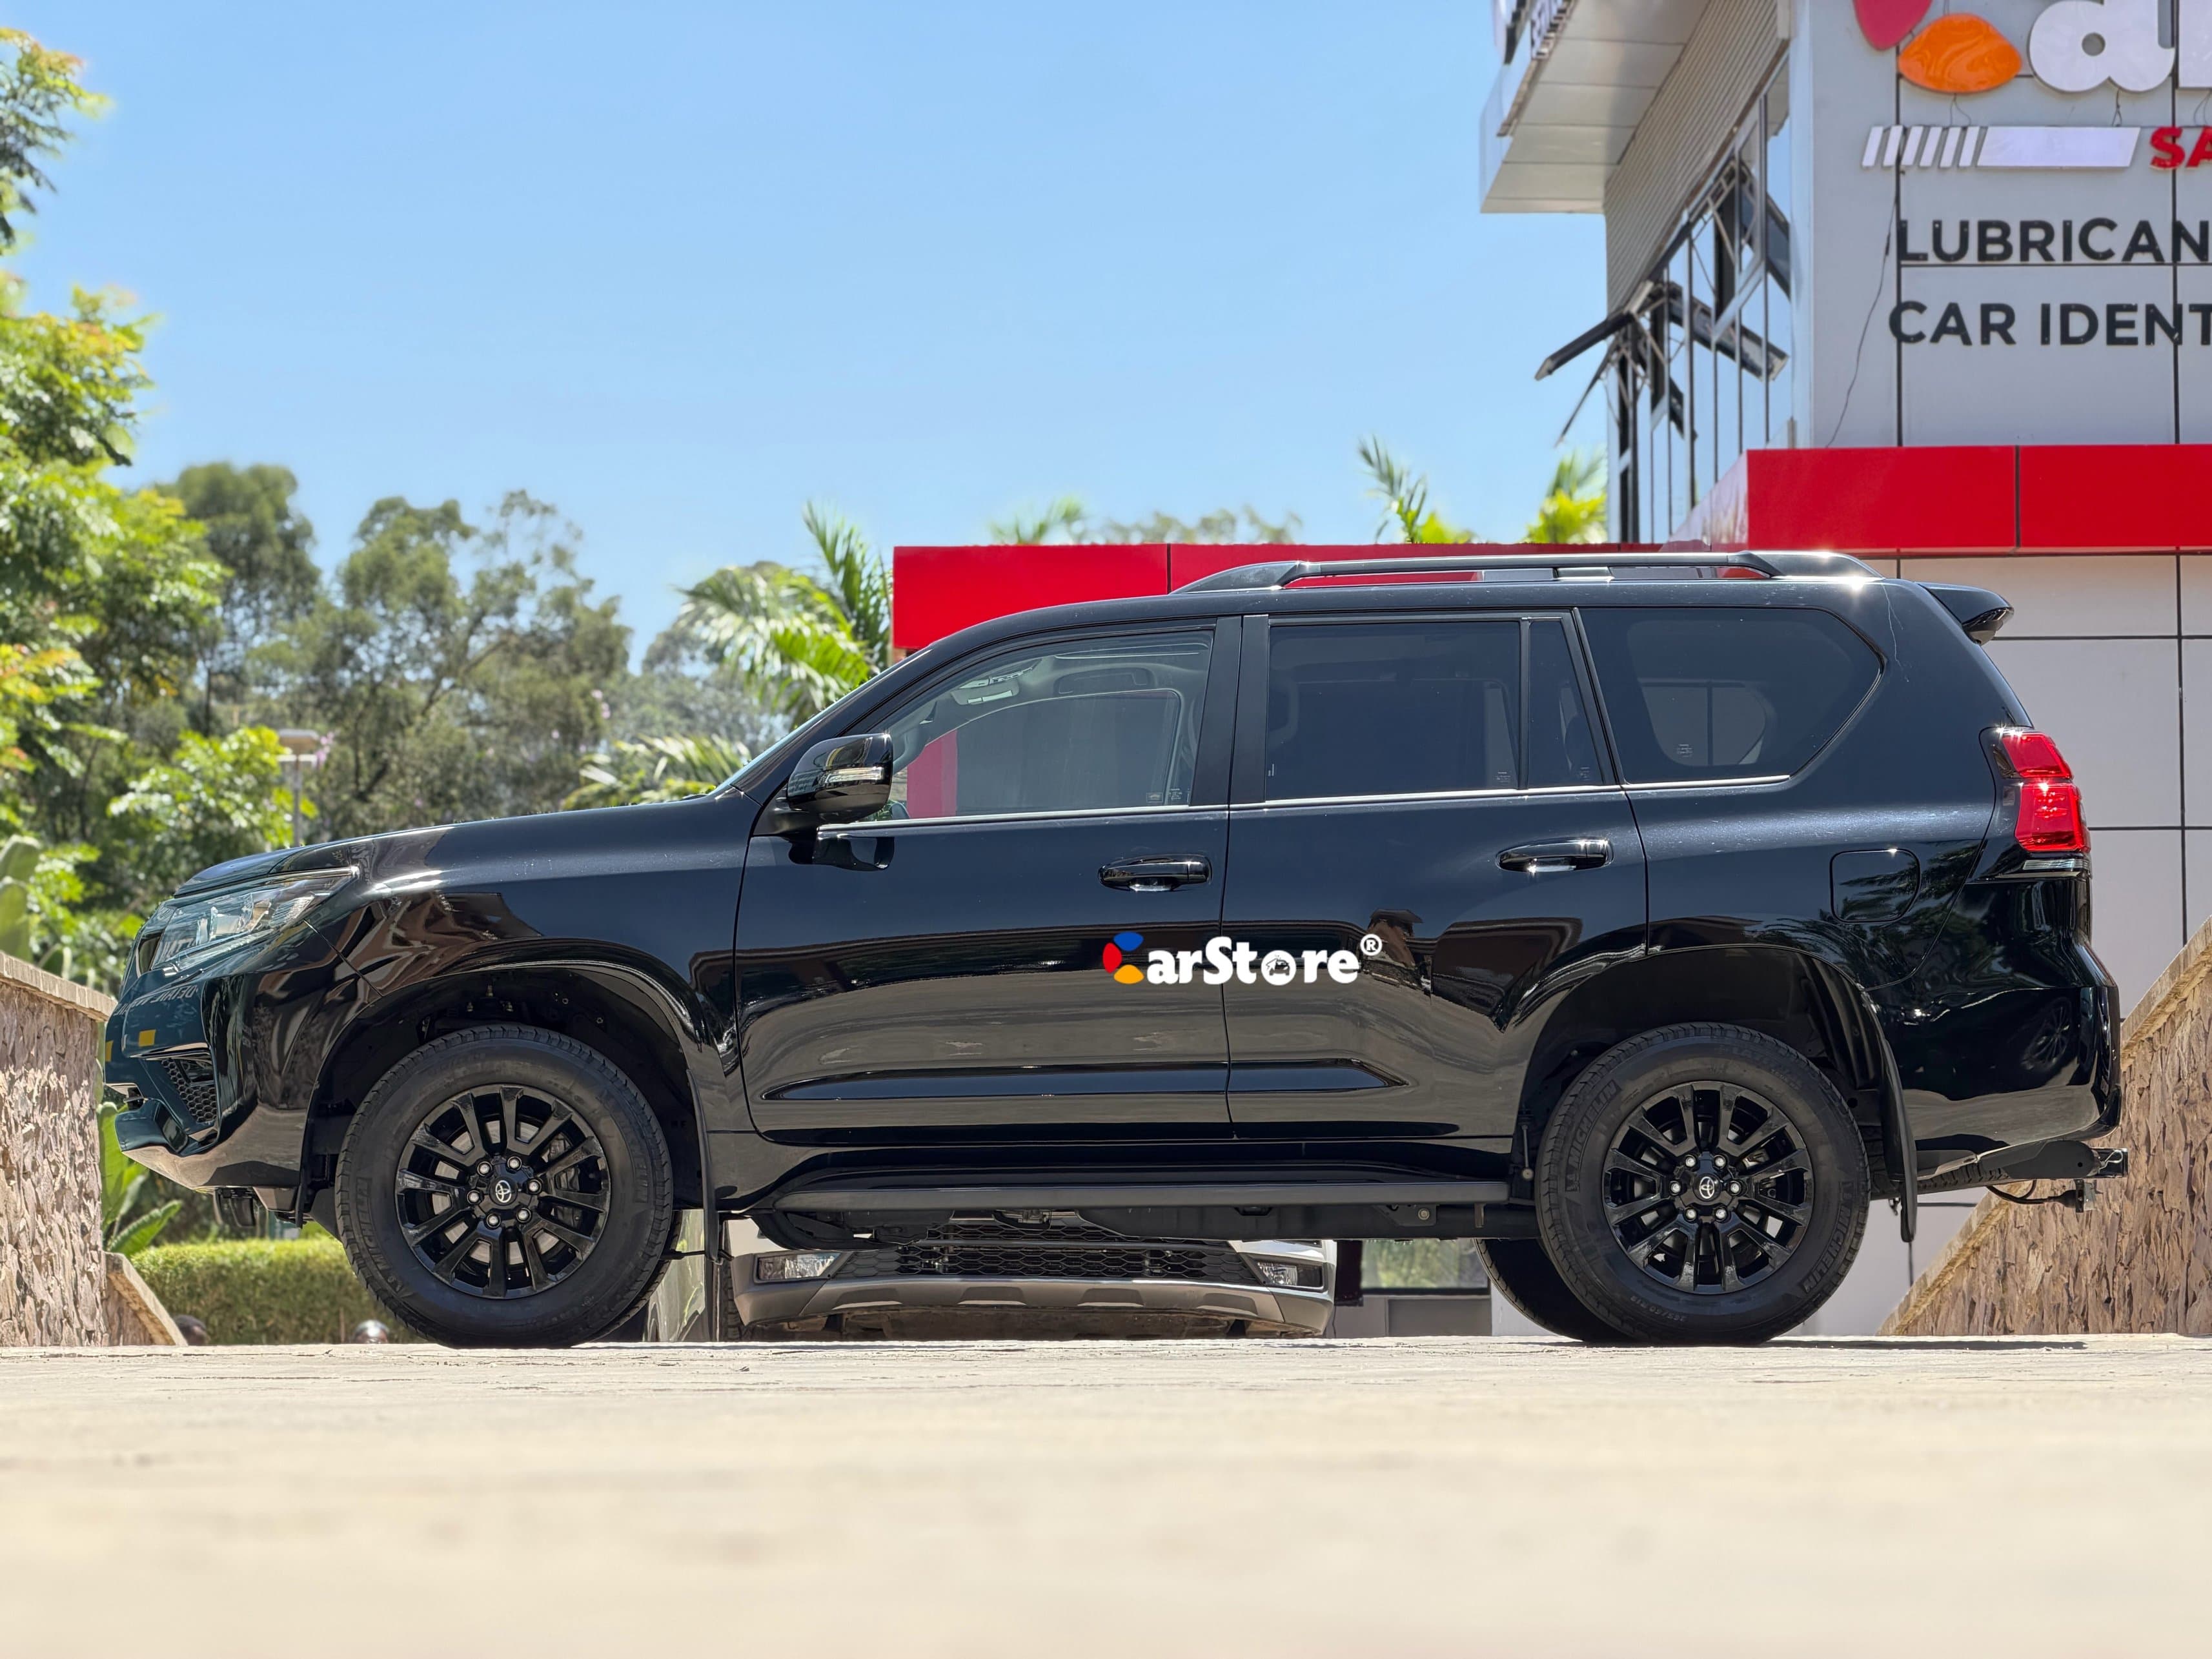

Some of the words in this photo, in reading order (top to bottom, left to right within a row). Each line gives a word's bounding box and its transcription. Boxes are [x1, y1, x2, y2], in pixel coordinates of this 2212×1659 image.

[1898, 218, 2209, 263] LUBRICAN
[1889, 301, 2016, 346] CAR
[2041, 303, 2212, 346] IDENT
[1566, 1080, 1620, 1168] MICHELIN
[1801, 1206, 1852, 1294] MICHELIN
